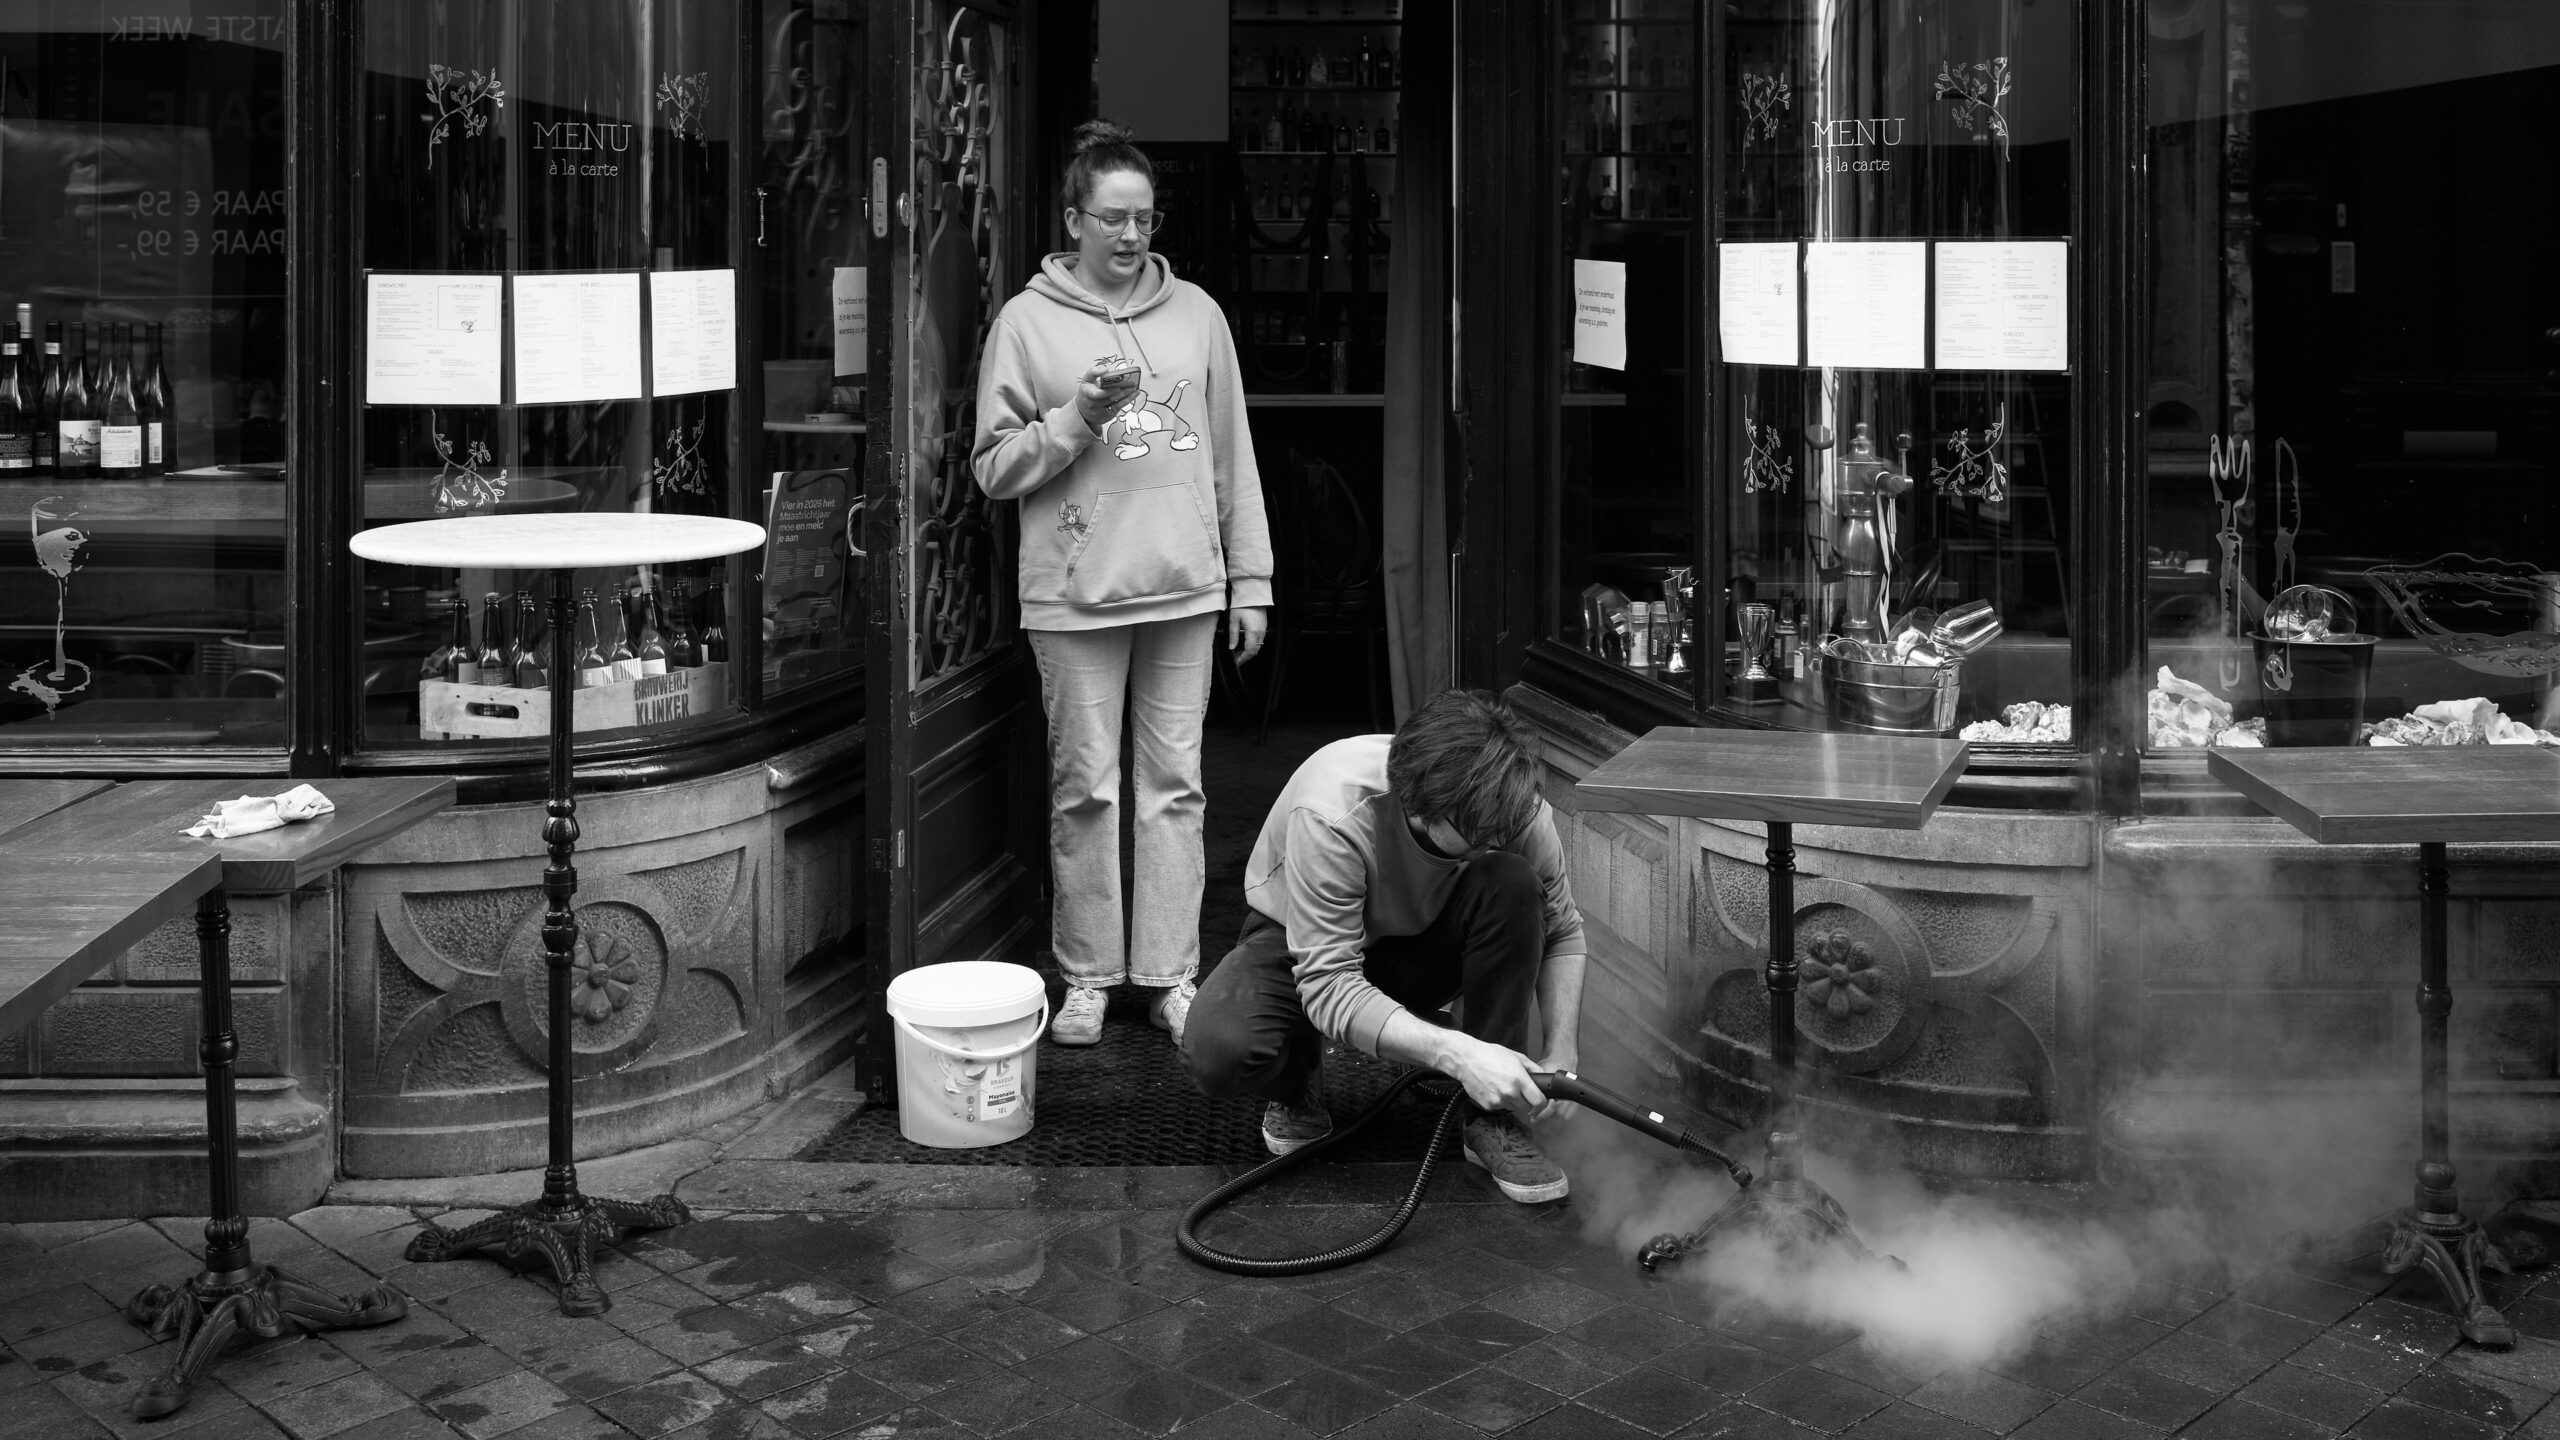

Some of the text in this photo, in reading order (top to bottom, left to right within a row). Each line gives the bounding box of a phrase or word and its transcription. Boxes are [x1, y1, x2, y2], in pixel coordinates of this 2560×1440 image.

[533, 121, 632, 152] MENU
[1811, 118, 1905, 149] MENU
[549, 158, 619, 177] à la carte
[1825, 156, 1890, 173] à la carte
[782, 499, 835, 510] Vier in 2026 het
[806, 520, 824, 530] meld
[776, 534, 784, 544] je
[634, 670, 689, 701] BROUWERIJ
[635, 693, 690, 726] KLINKER
